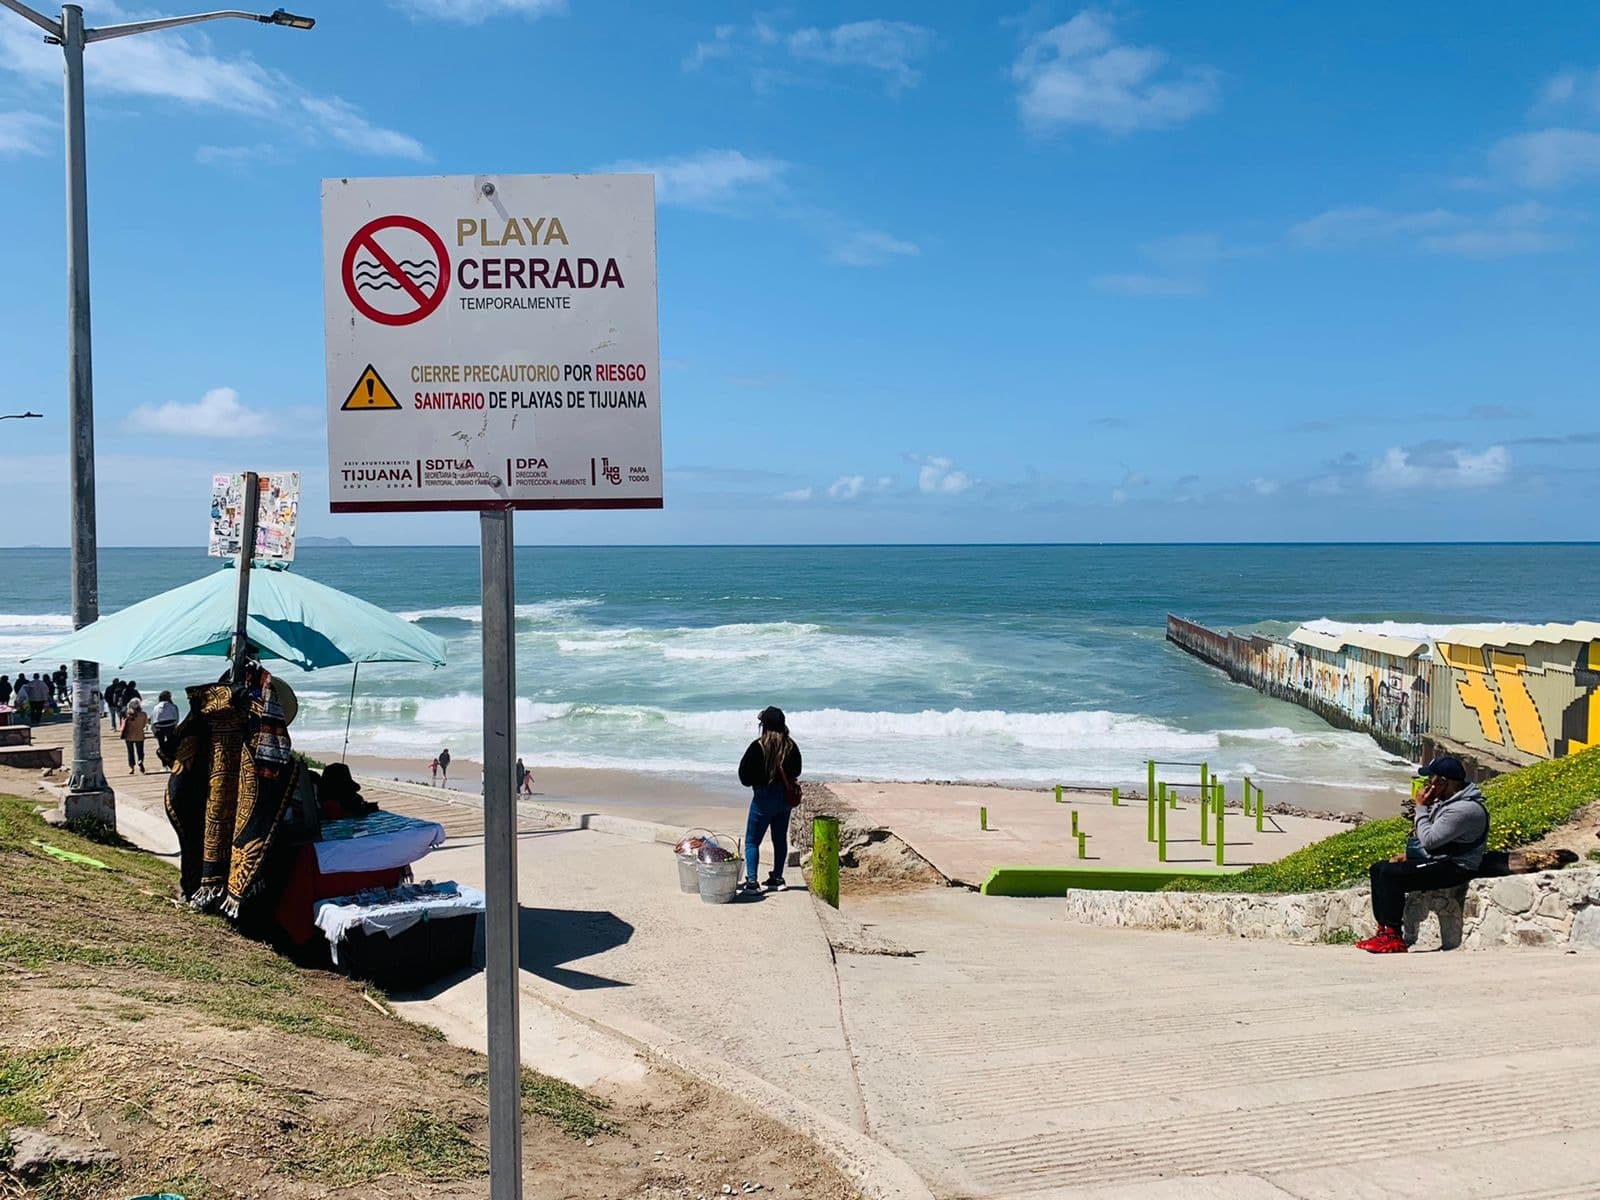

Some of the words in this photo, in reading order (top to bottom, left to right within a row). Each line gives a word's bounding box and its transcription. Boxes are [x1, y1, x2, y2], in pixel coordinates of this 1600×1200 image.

[456, 217, 569, 247] PLAYA
[457, 257, 625, 290] CERRADA
[459, 296, 571, 310] TEMPORALMENTE
[411, 365, 460, 383] CIERRE
[463, 364, 560, 382] PRECAUTORIO
[564, 364, 593, 381] POR
[595, 363, 647, 382] RIESGO
[414, 391, 485, 410] SANITARIO
[489, 391, 507, 409] DE
[511, 390, 563, 409] PLAYAS
[567, 390, 585, 409] DE
[588, 390, 648, 409] TIJUANA
[425, 459, 475, 470] SDTUA
[516, 458, 549, 469] DPA
[341, 468, 413, 481] TIJUANA
